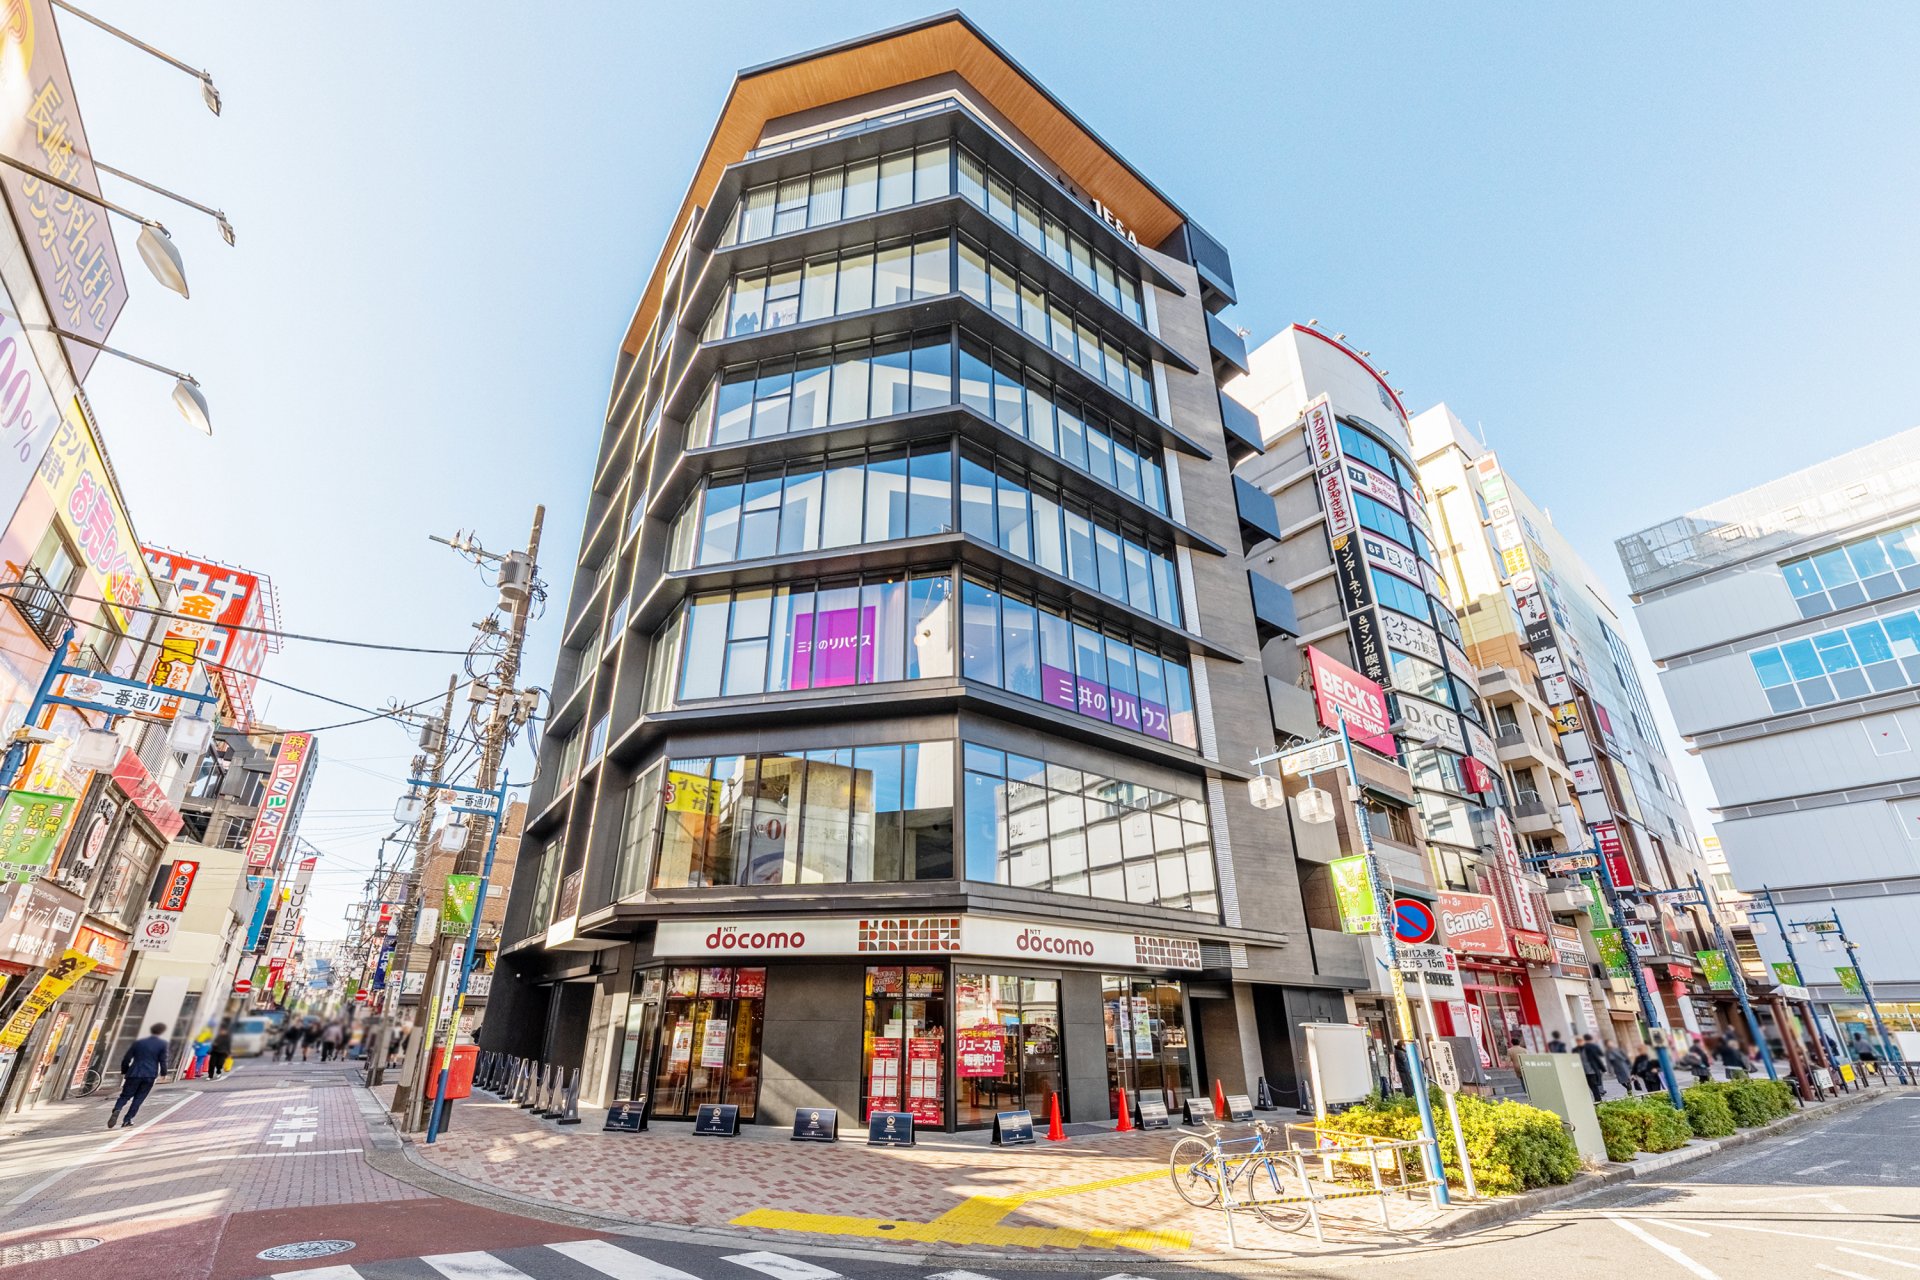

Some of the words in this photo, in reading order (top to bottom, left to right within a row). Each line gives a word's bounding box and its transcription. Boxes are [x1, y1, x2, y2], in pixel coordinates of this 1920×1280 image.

[26, 75, 116, 332] 長崎ちゃんぽん
[1321, 464, 1337, 475] 6F
[1352, 469, 1363, 481] 7F
[1367, 543, 1381, 558] 6F
[1386, 547, 1417, 577] 受付
[1341, 540, 1365, 608] インターネット
[177, 595, 217, 620] 金
[1382, 615, 1437, 645] インターネット
[1358, 615, 1383, 679] &マンガ喫茶
[100, 689, 162, 712] 一番通り
[1059, 679, 1168, 732] 三井のリハウス
[1318, 667, 1383, 720] BECK'S
[457, 796, 493, 810] 一番通り
[1499, 815, 1532, 923] ADORES
[166, 875, 190, 908] 吉野家
[1442, 903, 1494, 936] Game!
[705, 926, 805, 950] docomo
[1016, 929, 1095, 957] docomo
[1514, 934, 1553, 962] Game!
[1427, 960, 1445, 968] 15m
[1424, 971, 1455, 987] COFFEE
[958, 1039, 1002, 1052] リユース品
[964, 1053, 995, 1067] 販売中!
